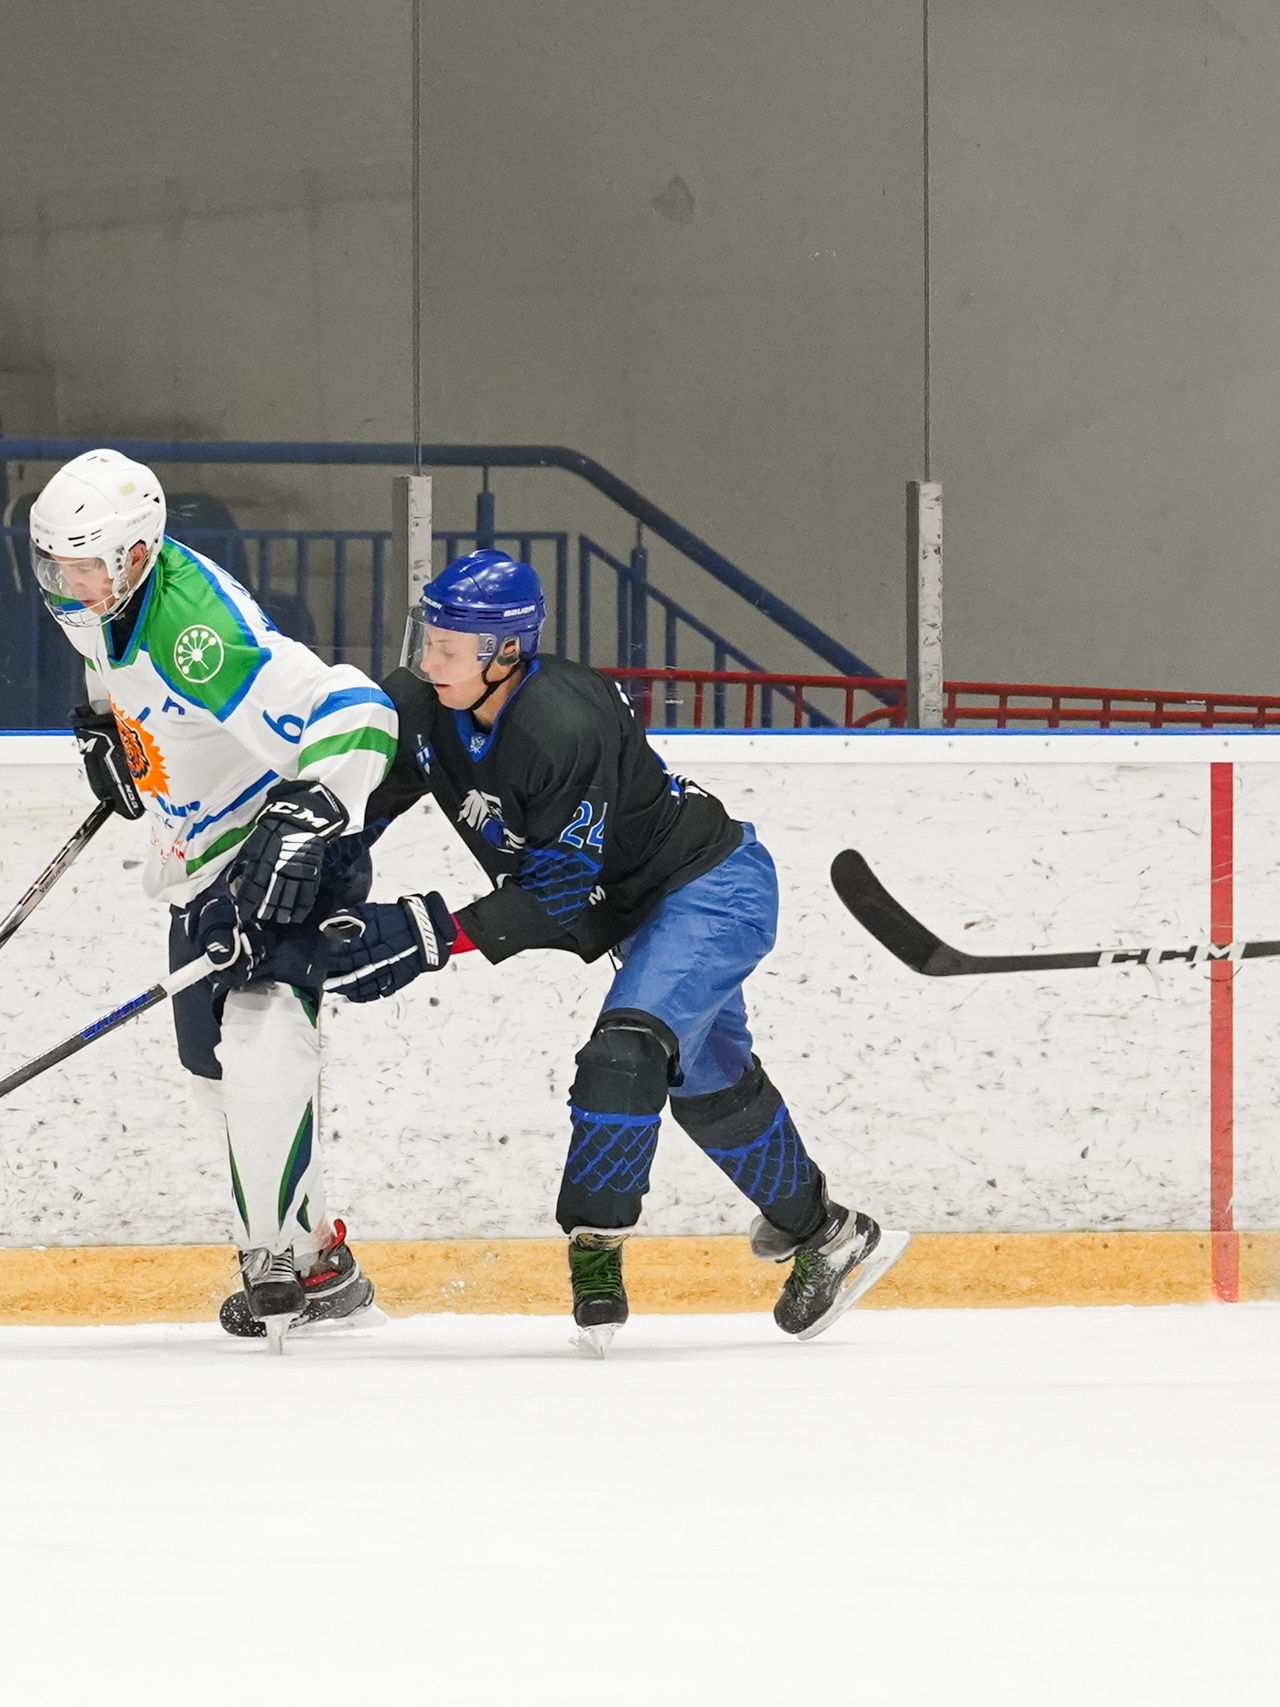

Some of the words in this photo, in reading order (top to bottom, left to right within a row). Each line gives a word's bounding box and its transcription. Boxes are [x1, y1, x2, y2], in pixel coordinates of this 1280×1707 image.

[503, 605, 536, 618] BAUER
[262, 709, 305, 744] 6
[124, 783, 139, 809] CCM
[1097, 942, 1247, 968] CCM
